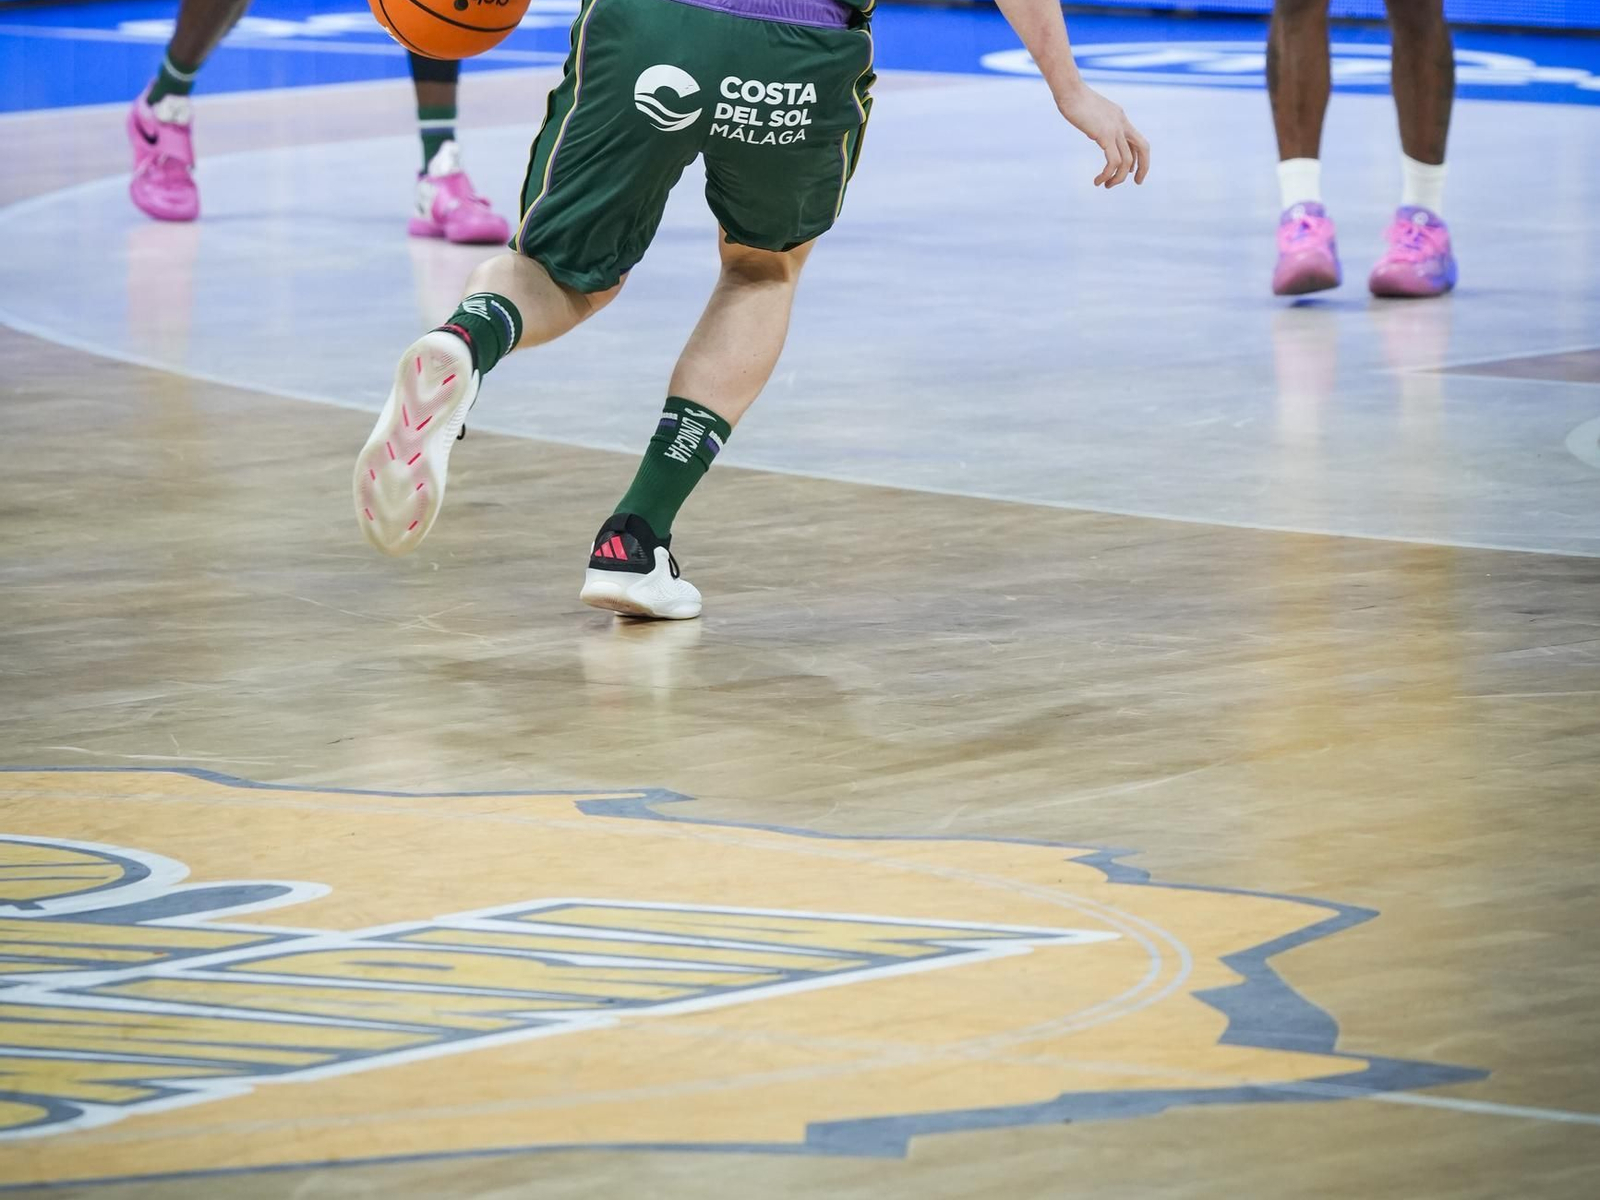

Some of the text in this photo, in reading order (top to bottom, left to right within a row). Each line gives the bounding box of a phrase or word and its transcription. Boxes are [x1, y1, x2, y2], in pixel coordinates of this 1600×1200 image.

[720, 76, 818, 105] COSTA
[714, 102, 813, 128] DEL SOL
[709, 122, 807, 146] MÁLAGA
